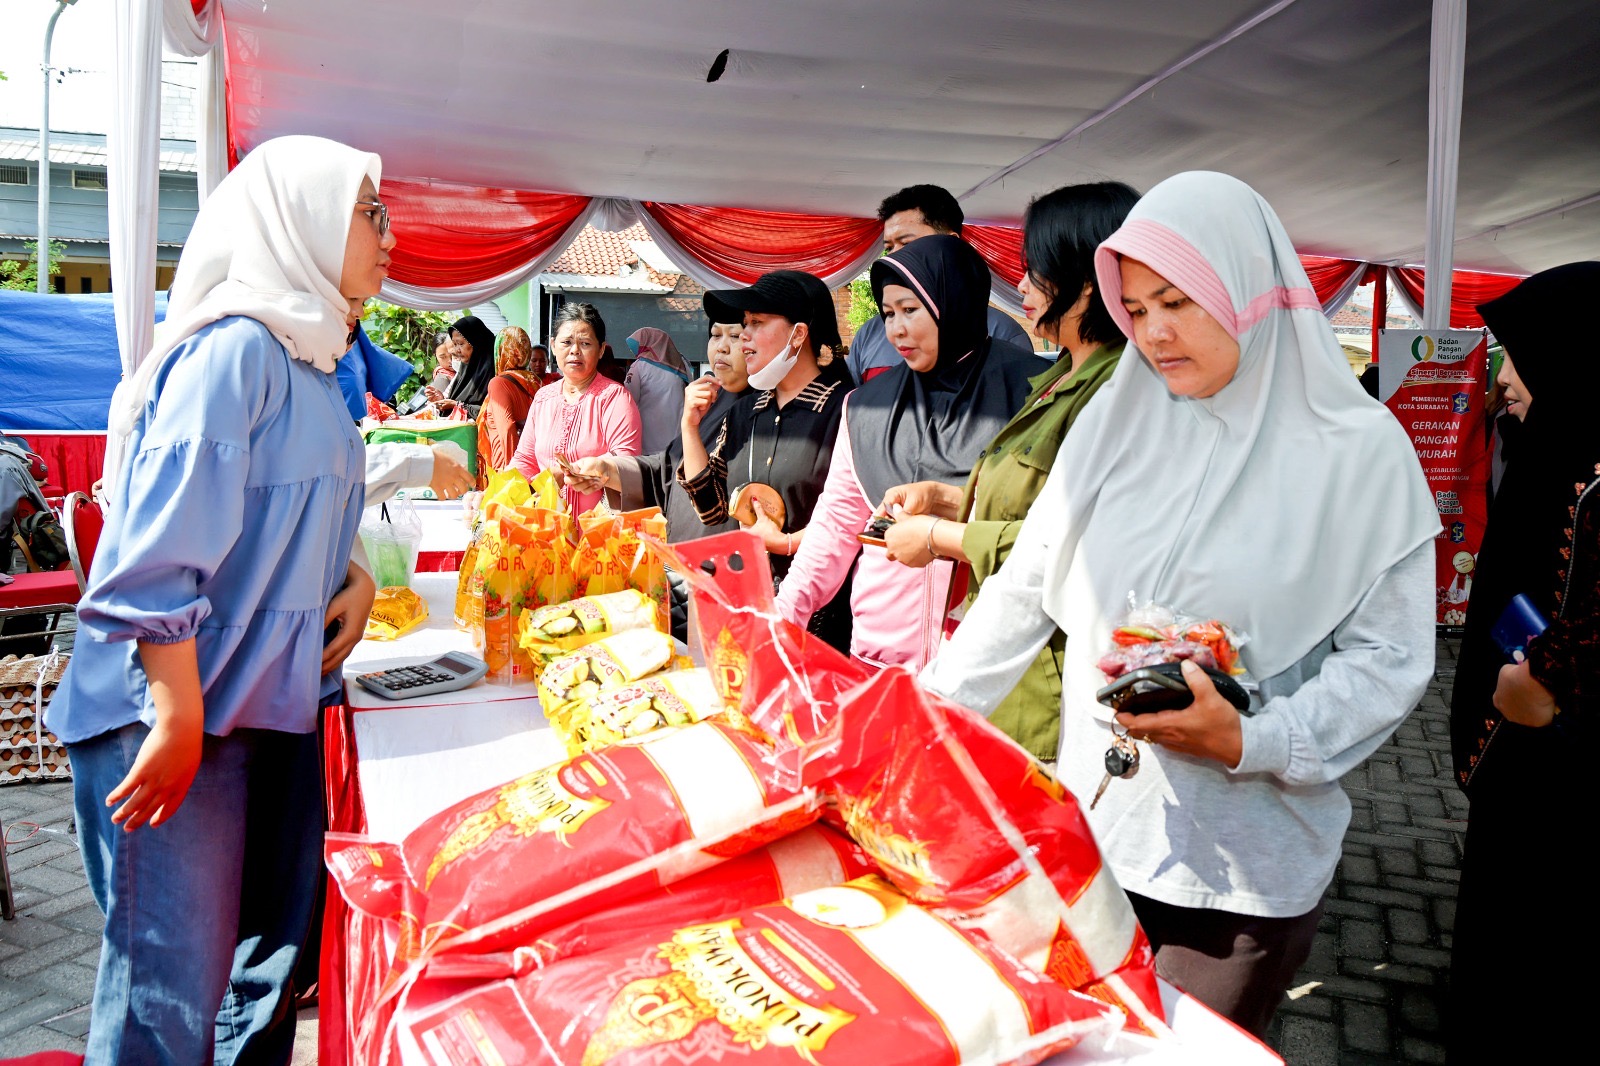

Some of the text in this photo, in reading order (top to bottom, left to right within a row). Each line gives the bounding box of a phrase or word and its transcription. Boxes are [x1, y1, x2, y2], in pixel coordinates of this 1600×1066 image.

[1411, 369, 1468, 377] Sinergi Bersama
[1412, 421, 1460, 430] GERAKAN
[1414, 435, 1458, 445] PANGAN
[1417, 449, 1457, 459] MURAH
[1436, 491, 1457, 499] Badan
[1437, 499, 1459, 507] Pangan
[692, 926, 824, 1039] PUNOKAWAN
[776, 970, 815, 999] BERAS
